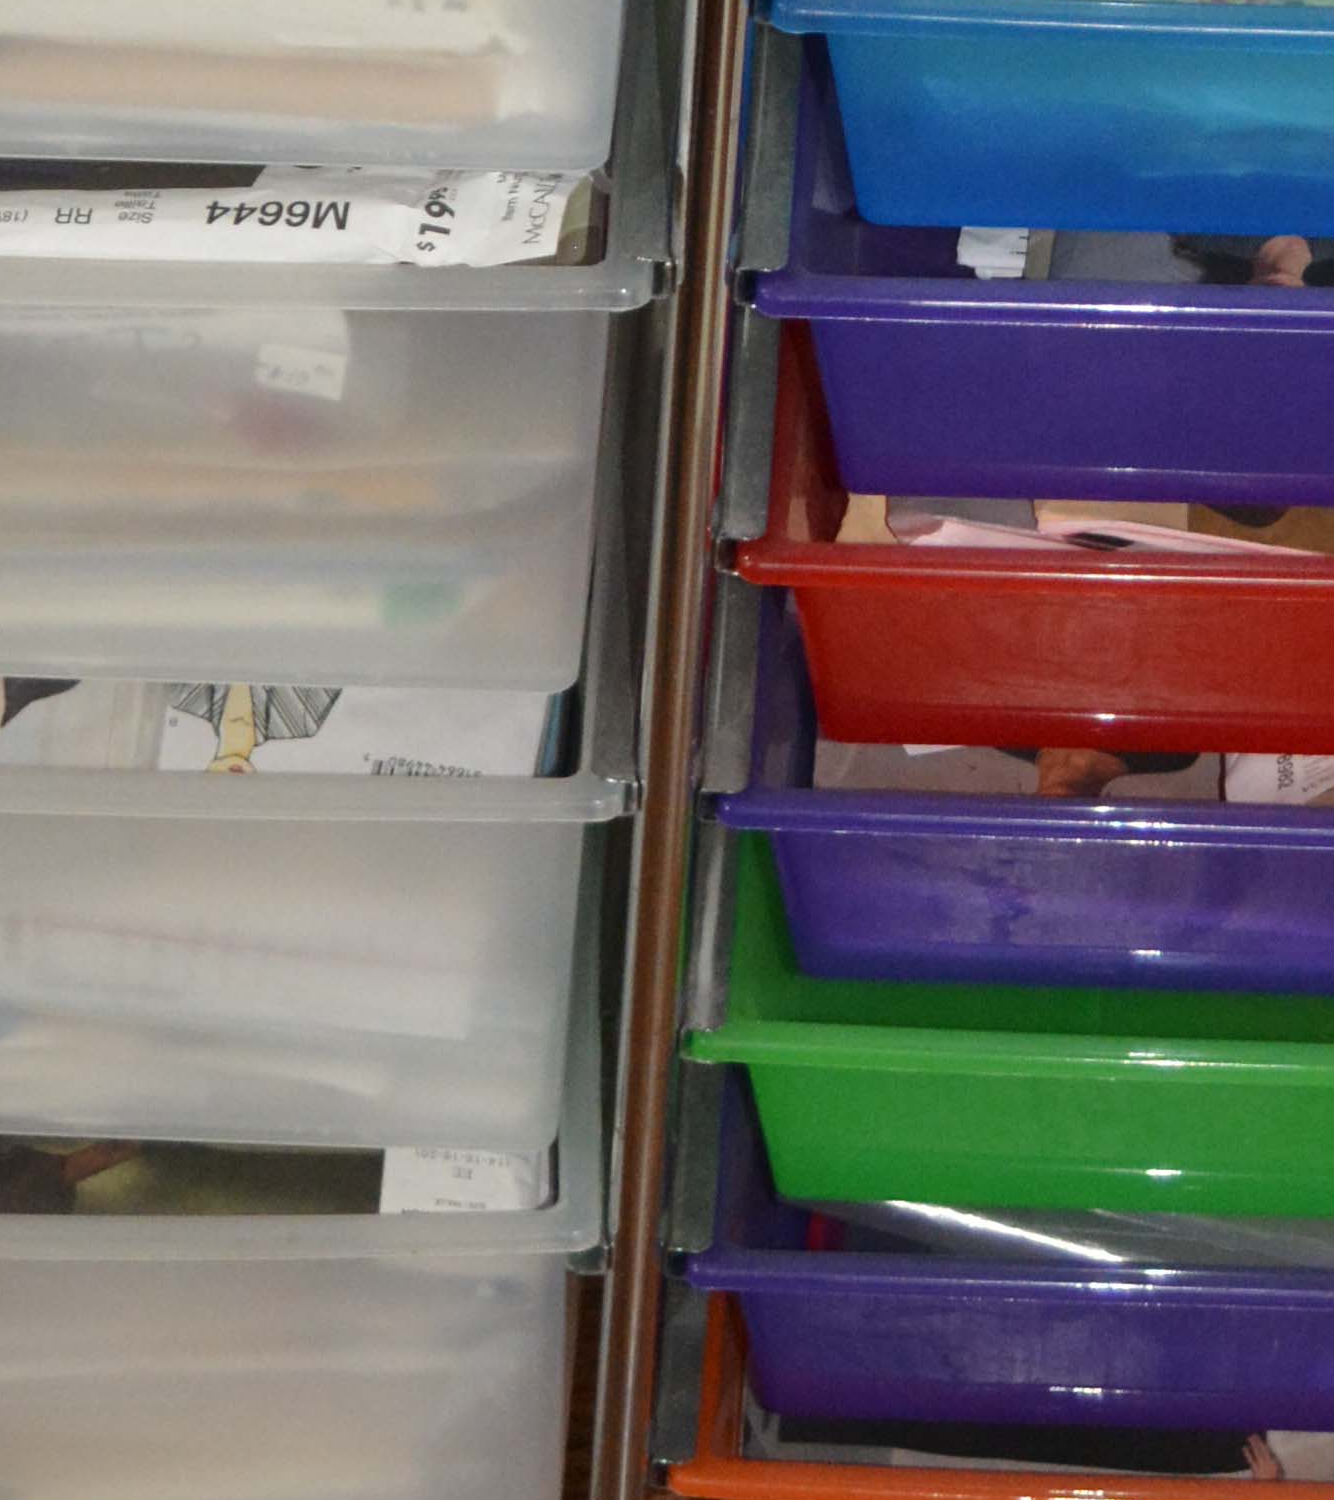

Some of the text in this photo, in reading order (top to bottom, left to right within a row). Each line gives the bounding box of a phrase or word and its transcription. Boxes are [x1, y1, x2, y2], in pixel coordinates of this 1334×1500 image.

[53, 205, 94, 225] RR
[117, 210, 155, 225] Size
[205, 199, 351, 231] M6644
